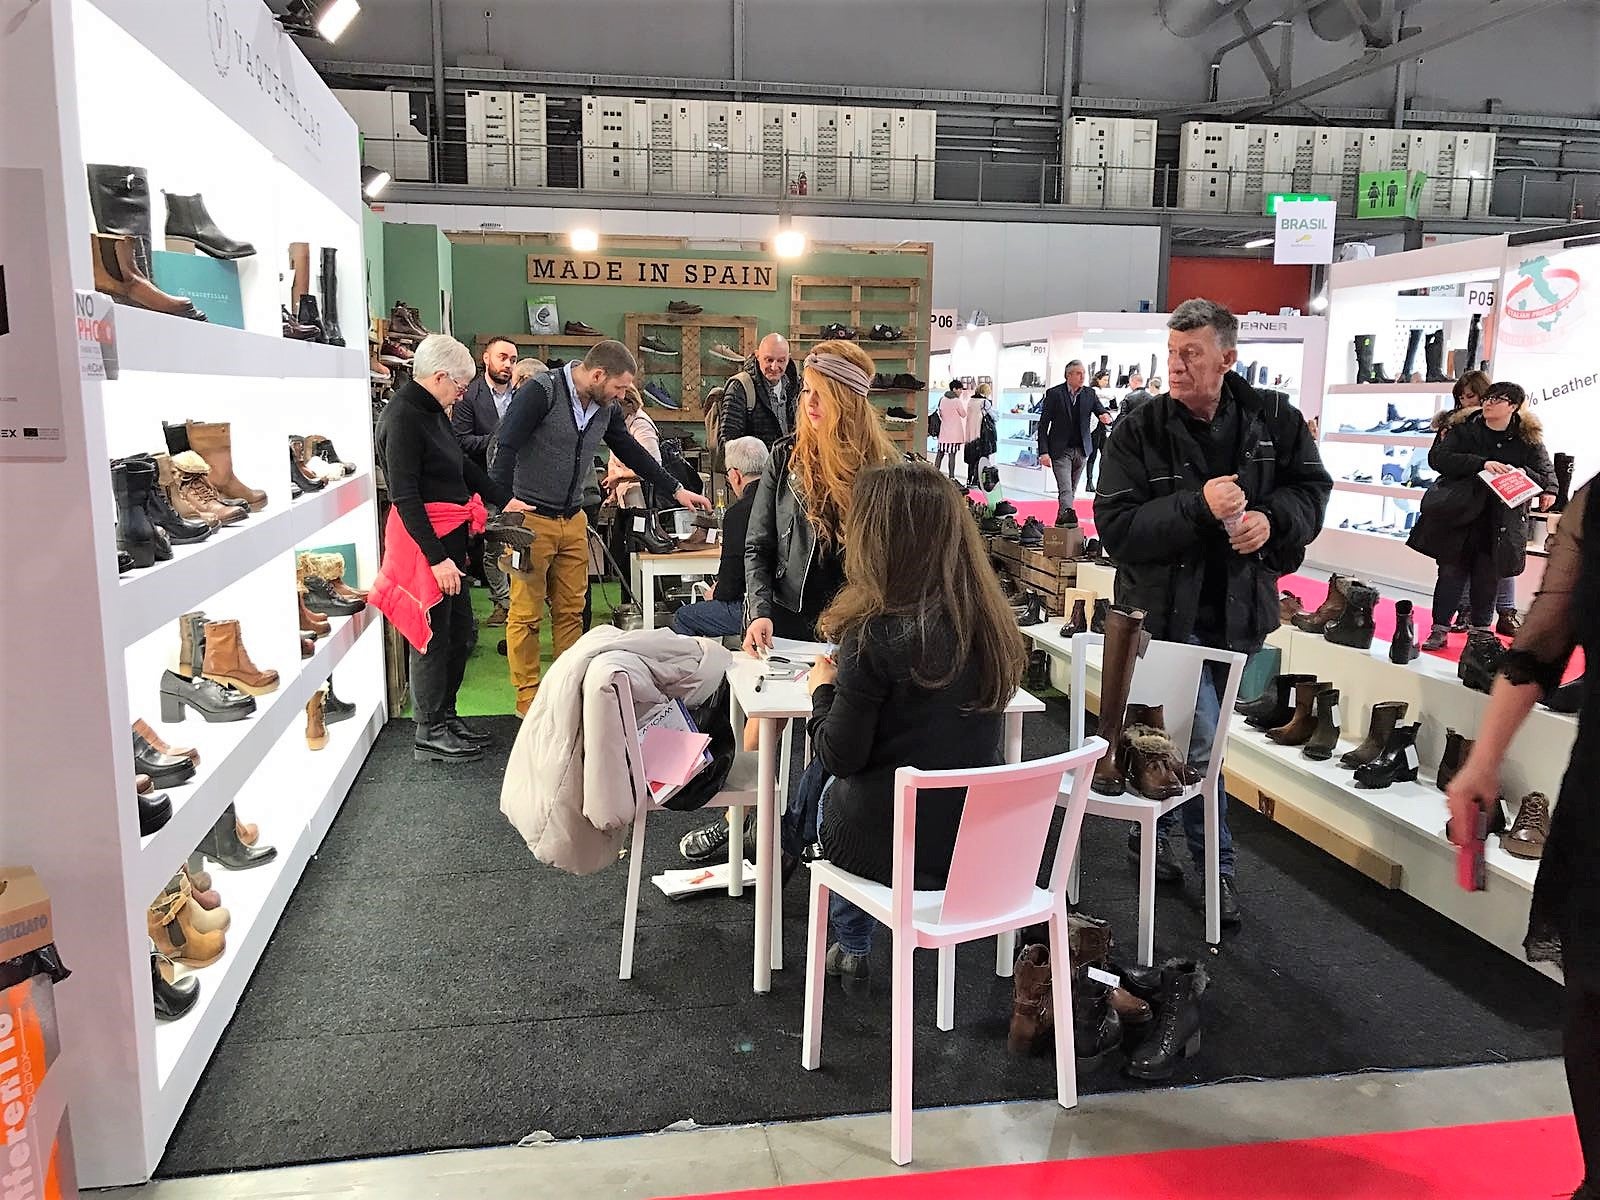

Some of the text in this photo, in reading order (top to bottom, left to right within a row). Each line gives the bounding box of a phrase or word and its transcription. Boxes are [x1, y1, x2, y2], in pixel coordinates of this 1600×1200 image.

[1281, 218, 1328, 230] BRASIL
[532, 258, 772, 286] MADE IN SPAIN
[76, 293, 94, 318] NO
[1468, 290, 1495, 307] P05
[1033, 345, 1046, 354] P01
[1542, 373, 1598, 402] Leather
